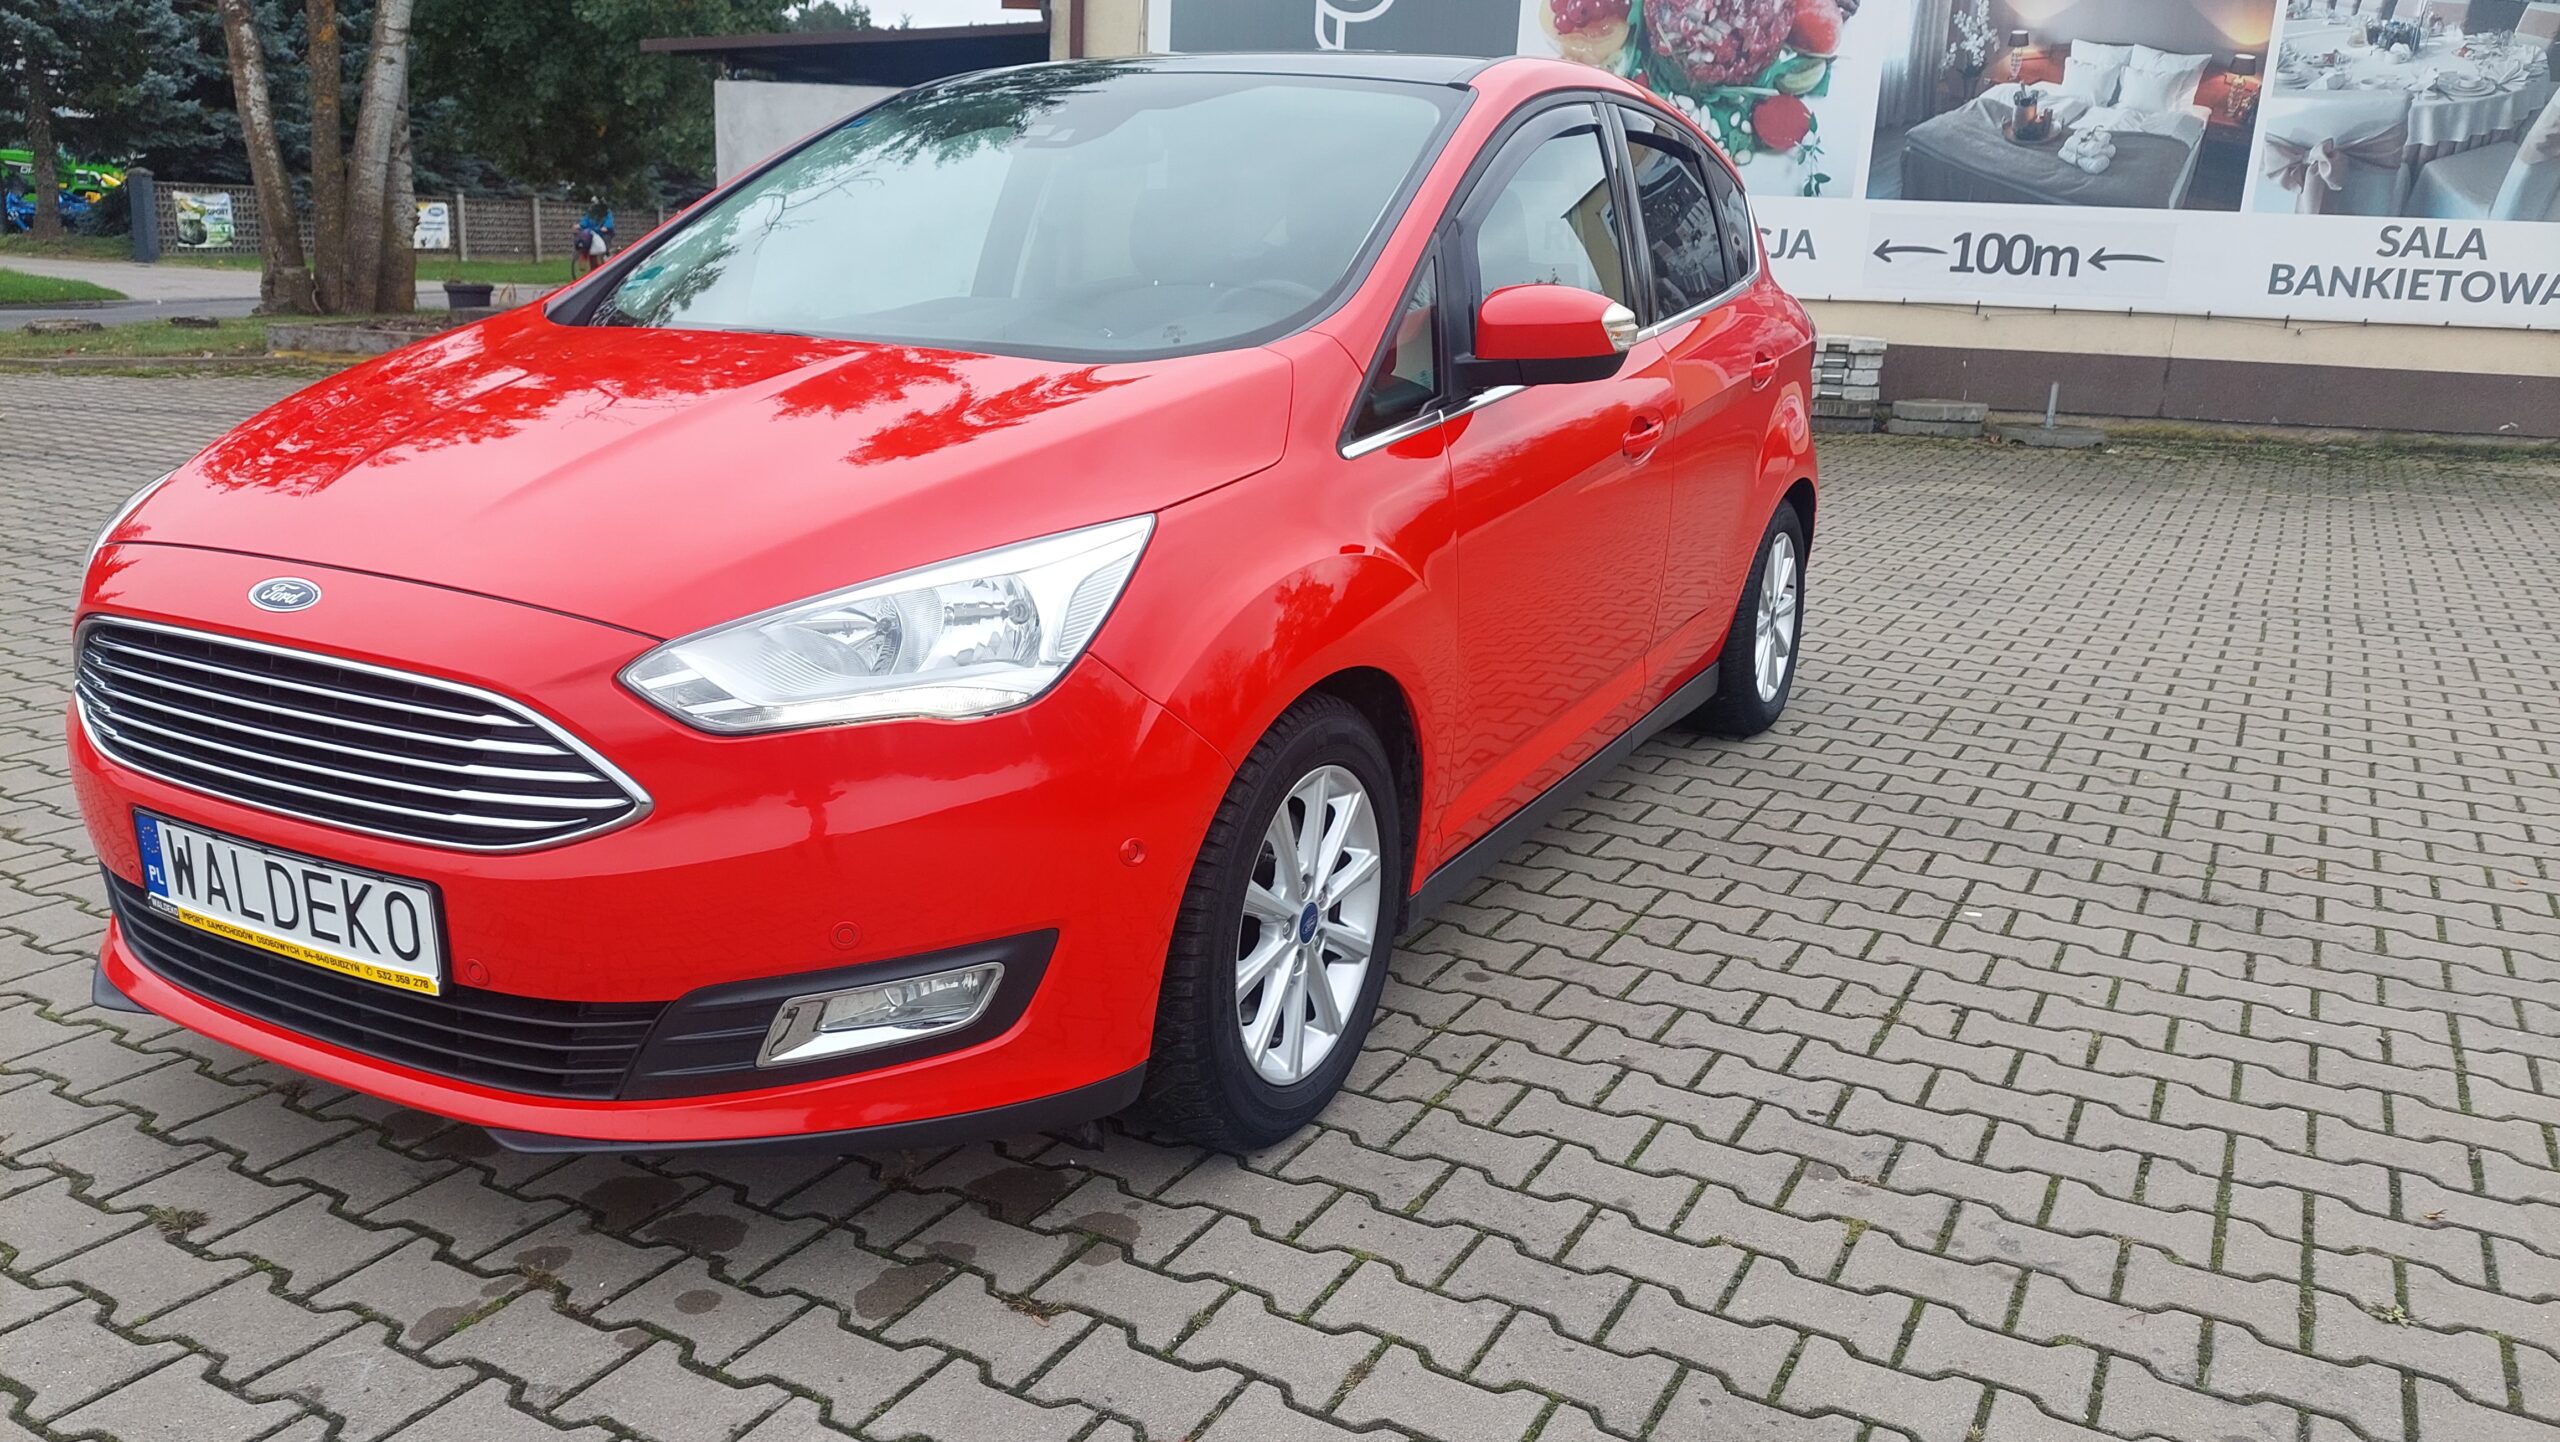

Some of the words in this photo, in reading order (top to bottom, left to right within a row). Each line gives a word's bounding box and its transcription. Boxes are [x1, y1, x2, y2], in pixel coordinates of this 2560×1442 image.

[1949, 232, 2080, 277] 100m
[2376, 224, 2488, 260] SALA
[2267, 262, 2560, 305] BANKIETOWA
[260, 583, 306, 604] Ford
[148, 864, 165, 885] PL
[151, 897, 179, 916] WALDEKO
[165, 828, 421, 962] WALDEKO
[182, 911, 205, 926] IMPORT
[256, 935, 301, 956] OSOBOWYCH
[377, 969, 393, 981] 532
[413, 977, 429, 989] 278
